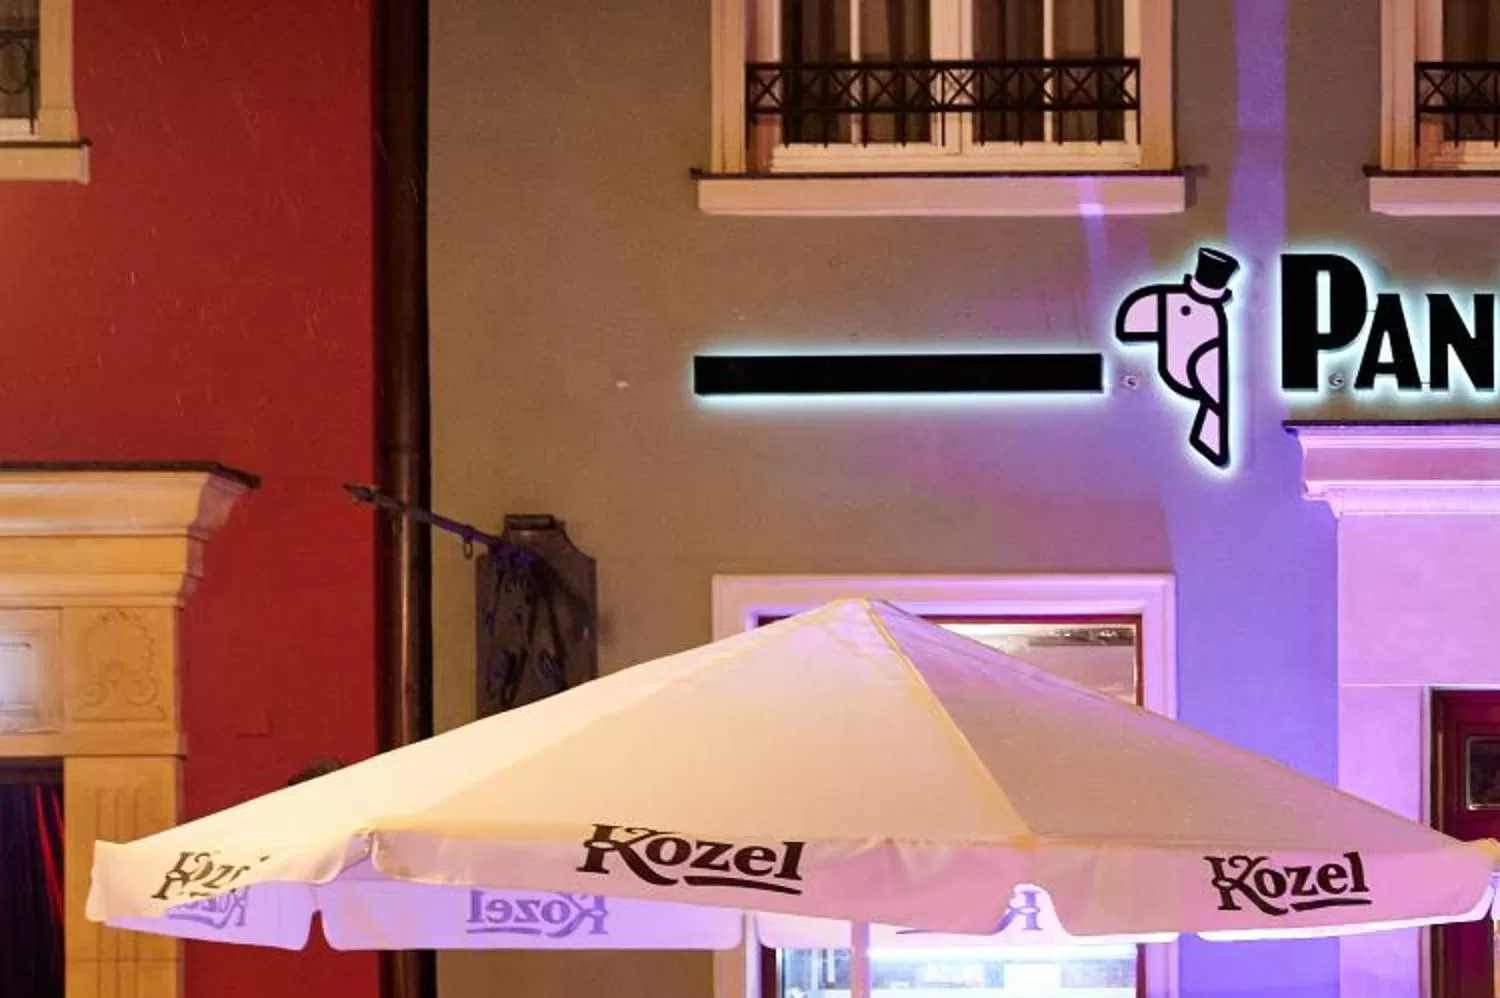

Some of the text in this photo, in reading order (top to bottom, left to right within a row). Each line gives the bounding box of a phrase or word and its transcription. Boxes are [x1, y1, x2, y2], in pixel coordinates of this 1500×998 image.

[1280, 252, 1496, 392] PAN
[576, 823, 807, 896] Kozel
[1203, 851, 1373, 917] Kozel
